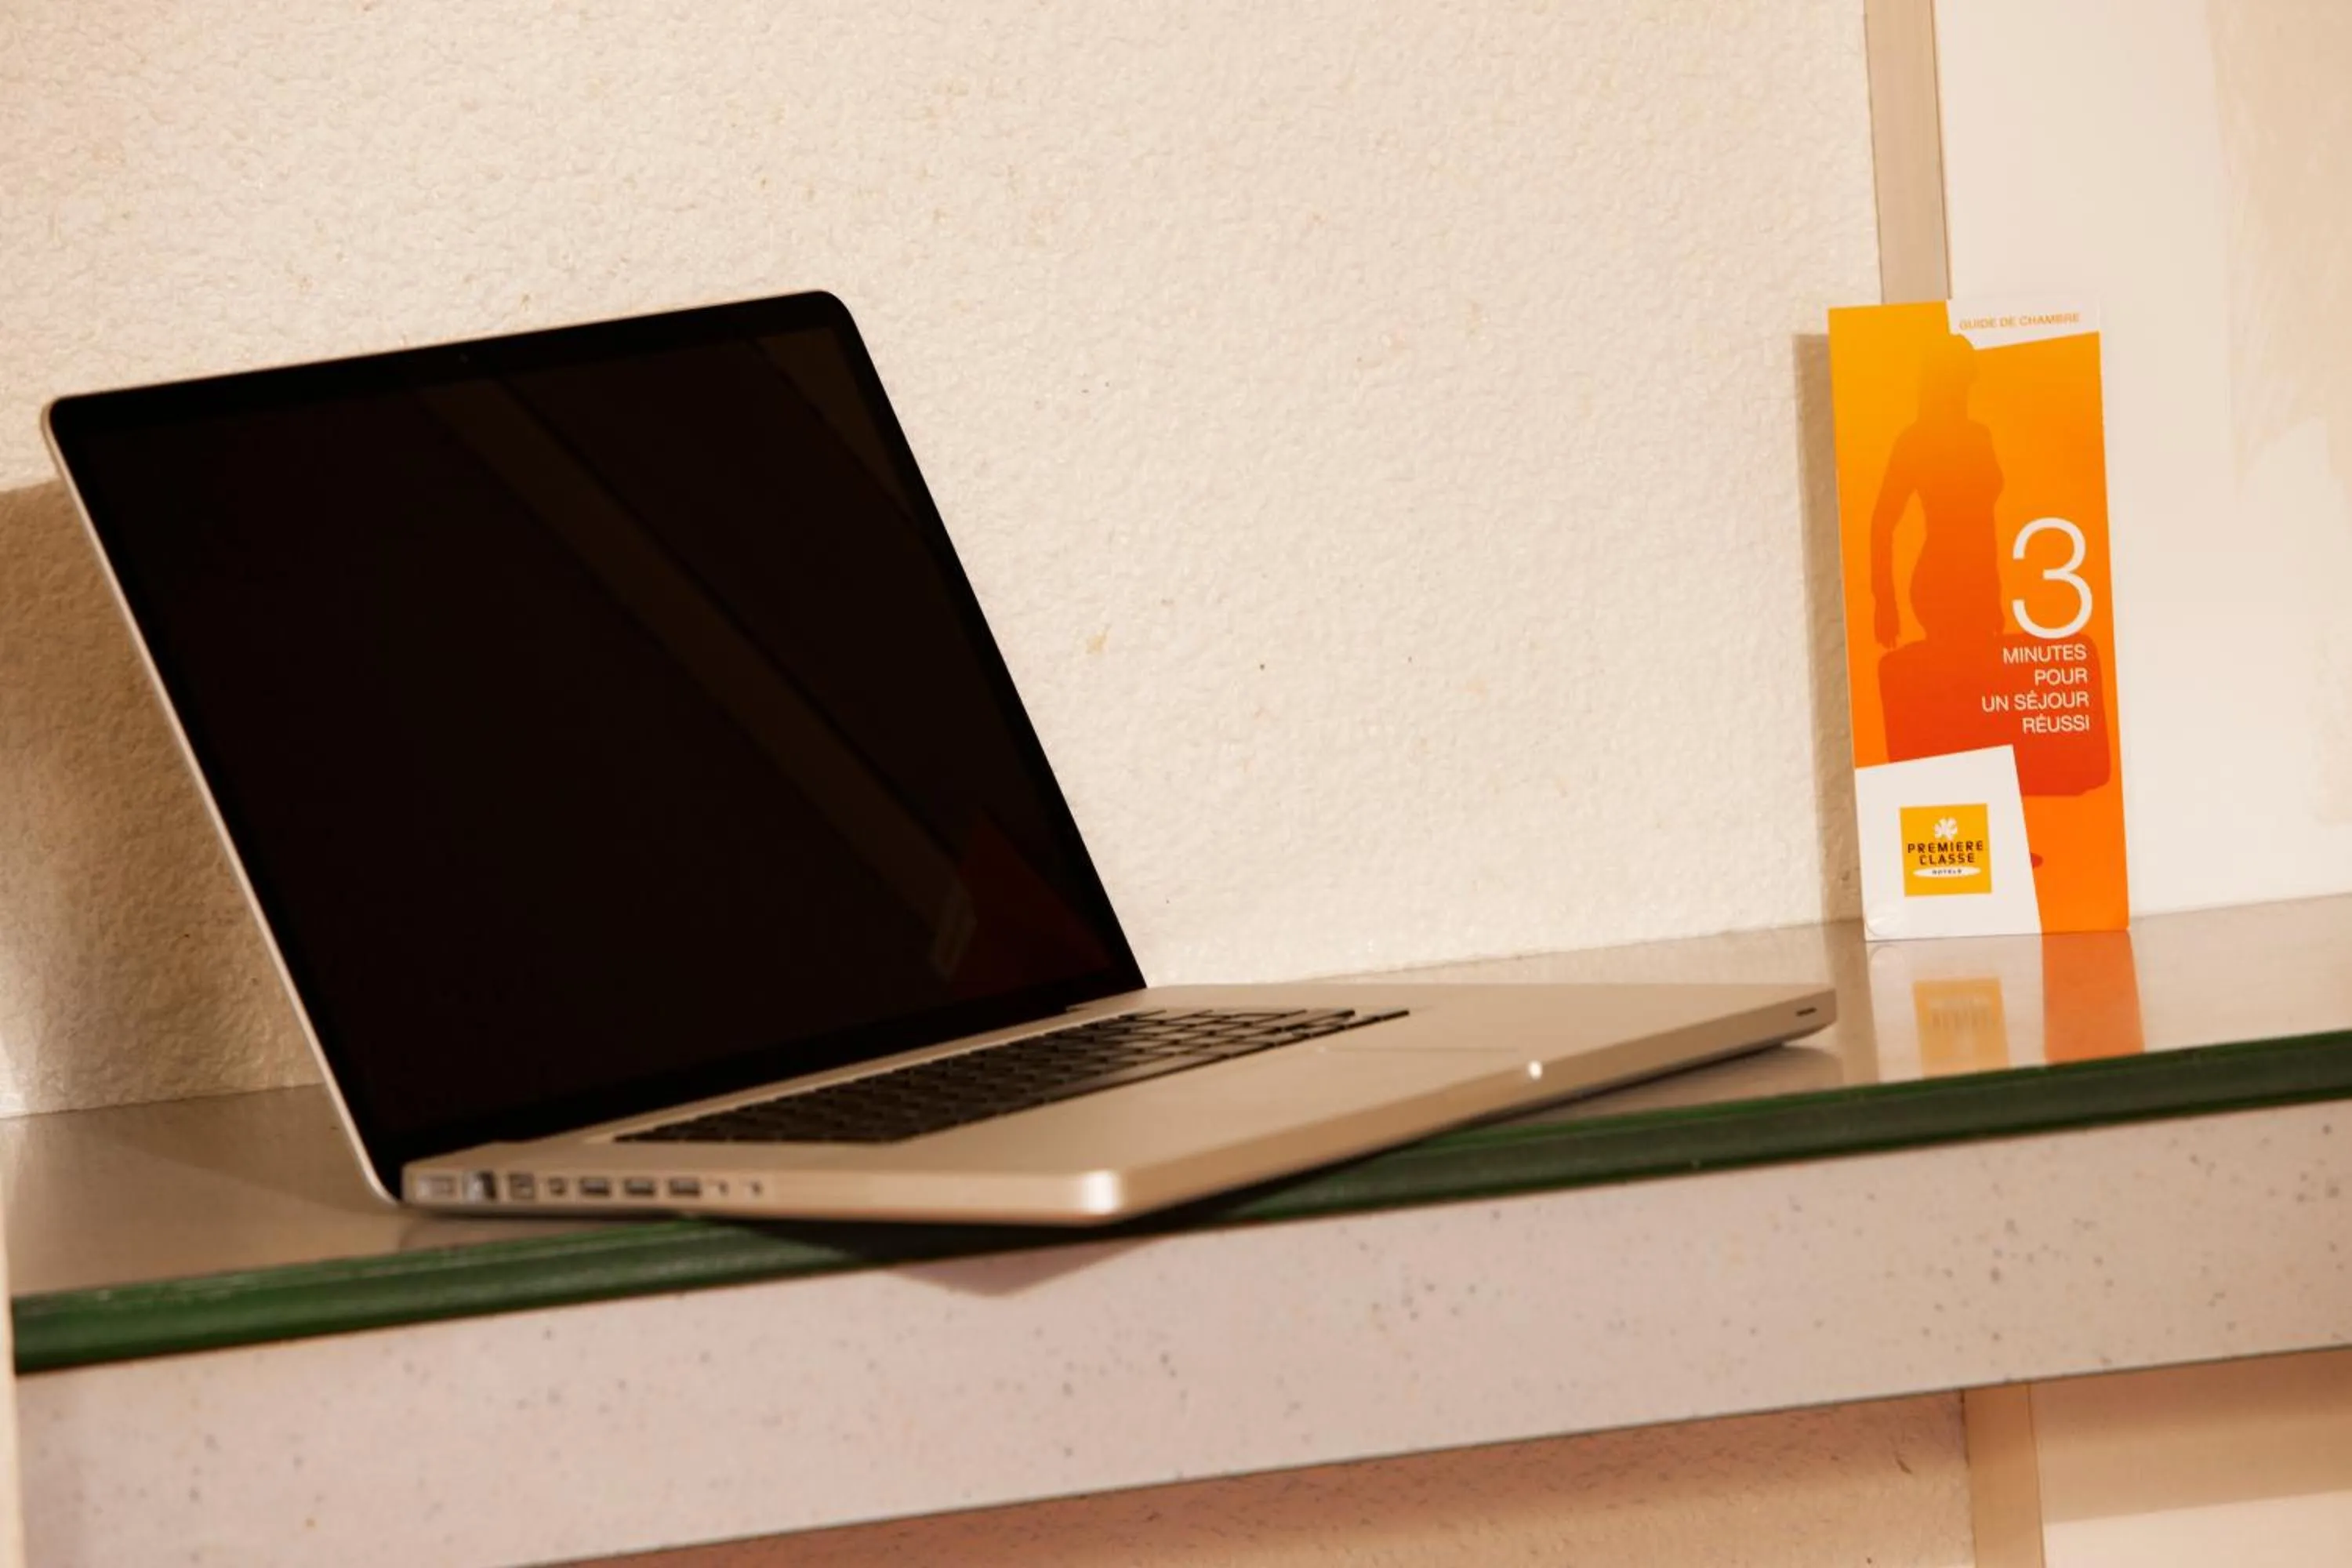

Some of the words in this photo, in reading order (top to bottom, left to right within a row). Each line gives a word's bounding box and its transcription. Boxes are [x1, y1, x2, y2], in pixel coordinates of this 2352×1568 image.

[1959, 317, 1998, 330] GUIDE
[2000, 315, 2017, 328] DE
[2019, 312, 2080, 326] CHAMBRE
[2013, 517, 2092, 639] 3
[2002, 643, 2087, 664] MINUTES
[2034, 667, 2088, 686] POUR
[1981, 695, 2009, 712] UN
[2013, 690, 2089, 710] SÉJOUR
[2022, 713, 2089, 734] RÉUSSI
[1907, 840, 1984, 853] PREMIERE
[1919, 853, 1976, 866] CLASSE
